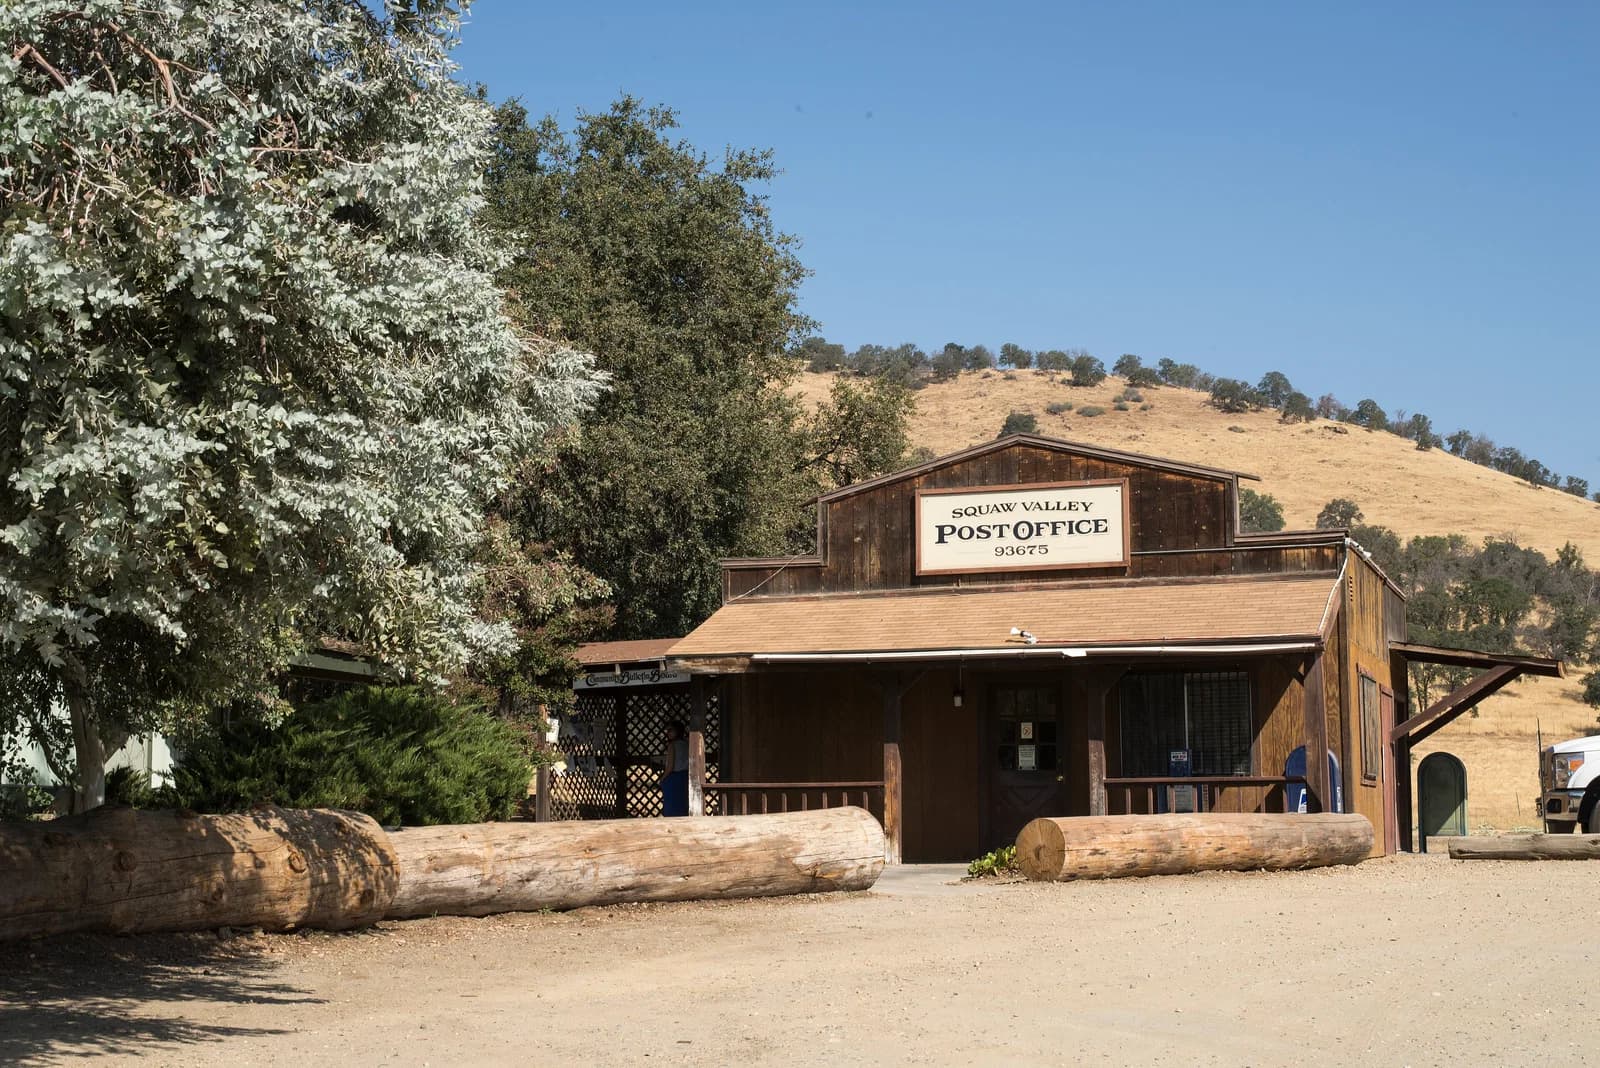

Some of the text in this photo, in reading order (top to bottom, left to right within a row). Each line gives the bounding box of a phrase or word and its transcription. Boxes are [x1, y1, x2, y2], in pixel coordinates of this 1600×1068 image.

[951, 501, 1094, 519] SQUAW VALLEY
[934, 518, 1108, 545] POST OFFICE
[994, 544, 1049, 557] 93675
